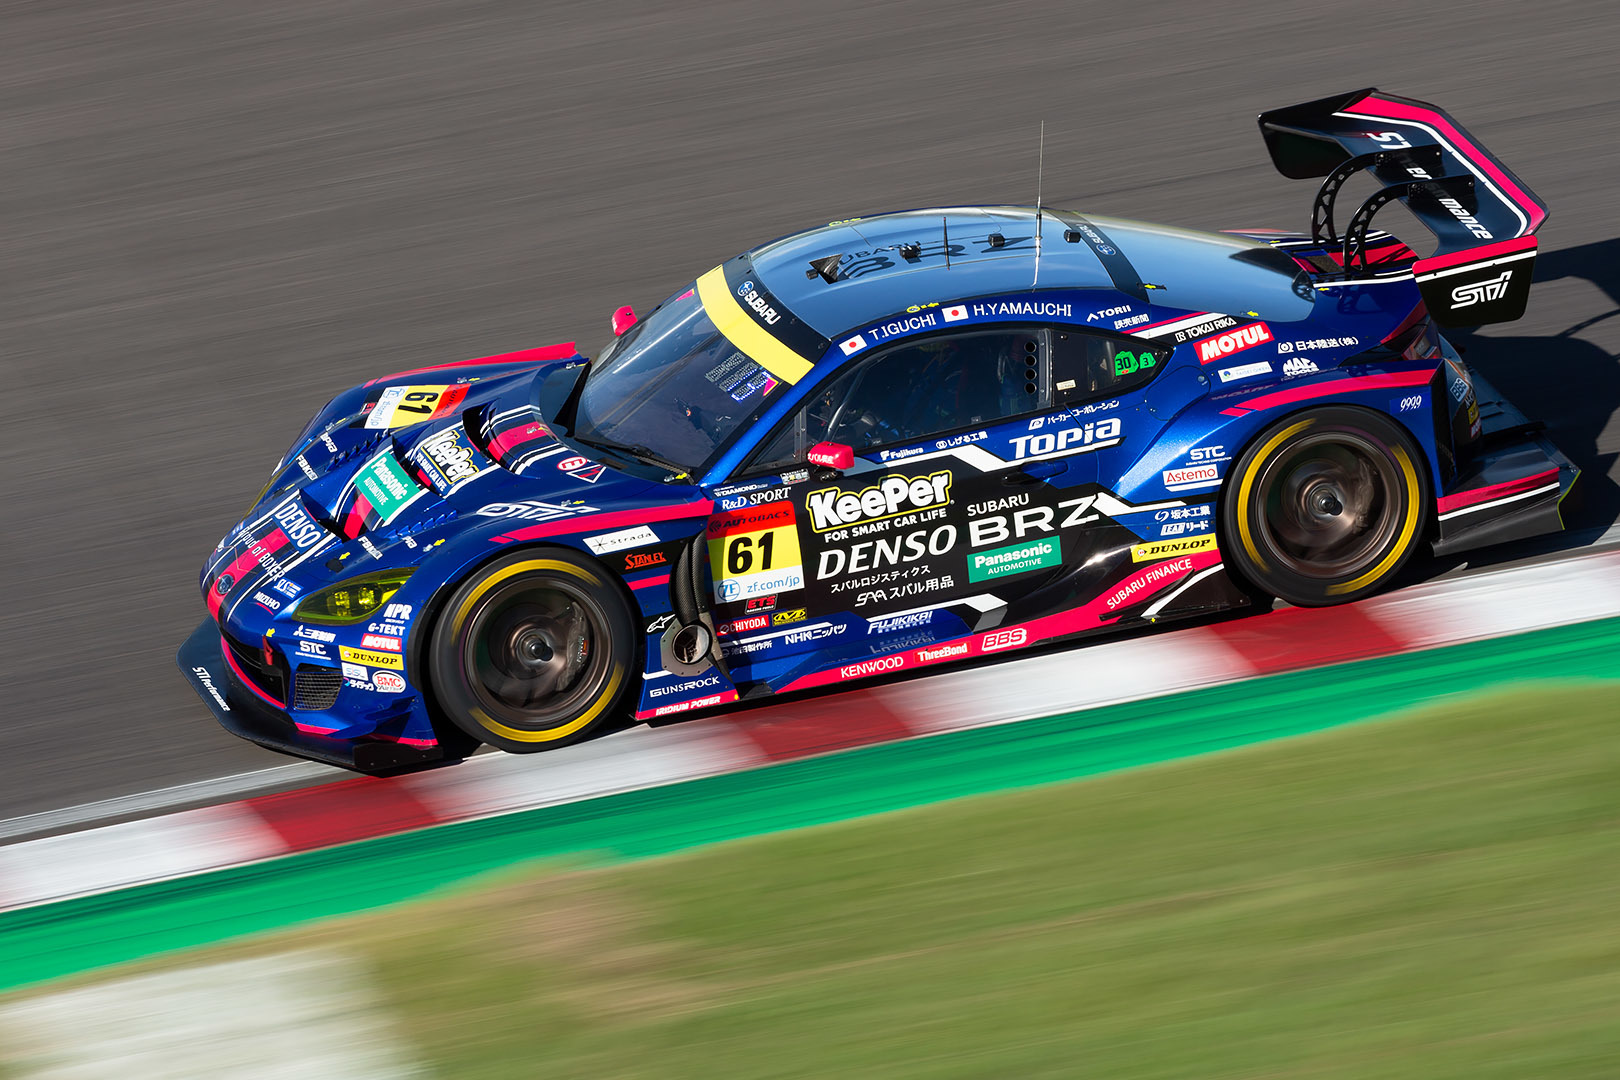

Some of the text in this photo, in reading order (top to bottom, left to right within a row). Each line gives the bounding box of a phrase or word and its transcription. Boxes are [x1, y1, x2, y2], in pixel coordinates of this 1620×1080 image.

[744, 290, 781, 325] SUBARU
[972, 302, 1072, 317] H.YAMAUCHI
[868, 313, 937, 341] T.IGUCHI
[1185, 317, 1238, 339] TOKAI RIKA
[1202, 324, 1270, 362] MOTUL
[1116, 356, 1131, 370] 30
[1143, 358, 1149, 366] 3
[1282, 357, 1318, 373] MAC
[398, 392, 439, 414] 61
[890, 447, 924, 459] Fujikura
[1190, 445, 1226, 460] STC
[370, 456, 408, 500] Panasonic
[1166, 468, 1216, 483] Astemo
[364, 476, 389, 506] AUTOMOTIVE
[722, 496, 748, 510] R&D
[750, 486, 792, 505] SPORT
[966, 493, 1029, 517] SUBARU
[274, 502, 322, 548] DENSO
[722, 510, 790, 528] AUTOBACS
[824, 508, 947, 543] FOR SMART CAR LIFE
[968, 494, 1099, 548] BRZ
[1186, 520, 1208, 532] リード
[610, 532, 652, 546] Strada
[1149, 539, 1210, 554] DUNLOP
[252, 545, 267, 558] of
[624, 551, 667, 570] STANLEY
[728, 531, 774, 575] 61
[816, 524, 957, 580] DENSO
[974, 542, 1052, 568] Panasonic
[258, 552, 286, 582] BOXER
[988, 557, 1042, 576] AUTOMOTIVE
[746, 575, 800, 593] zf.com/jp
[830, 565, 931, 594] スバルロジスティクス
[889, 574, 954, 600] スバル用品
[1106, 558, 1192, 610] SUBARU FINANCE
[253, 592, 280, 610] MIZUHO
[748, 596, 776, 609] ETS
[383, 604, 412, 620] NPR
[368, 622, 406, 636] G-TEKT
[730, 617, 766, 632] CHIYODA
[300, 640, 326, 655] STC
[362, 635, 400, 650] MOTUL
[982, 628, 1027, 651] BBS
[352, 652, 398, 665] DUNLOP
[917, 643, 968, 662] ThreeBond
[840, 656, 904, 678] KENWOOD
[376, 676, 402, 688] BMC
[656, 696, 721, 716] IRIDIUM POWER
